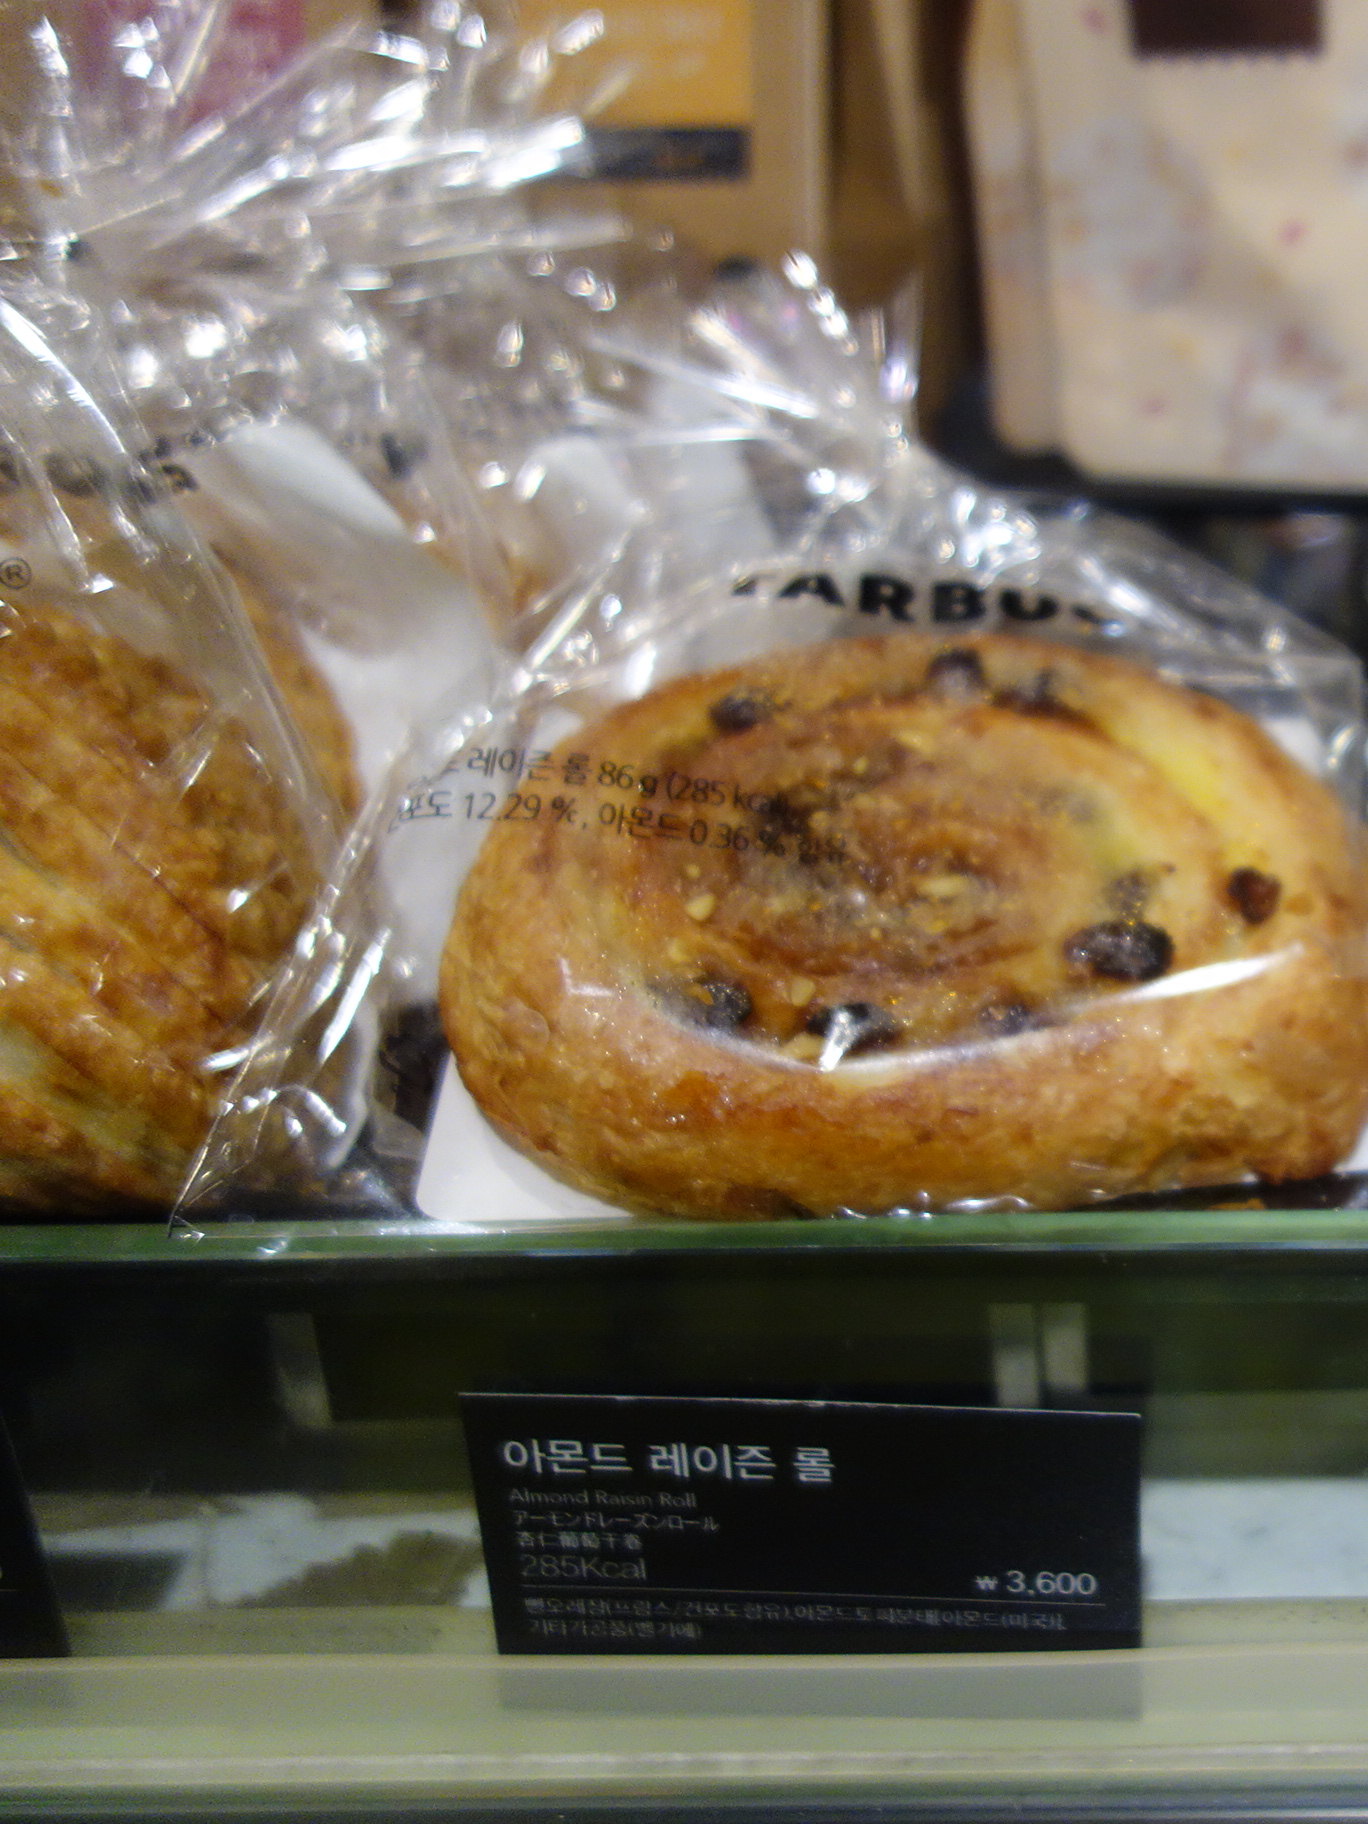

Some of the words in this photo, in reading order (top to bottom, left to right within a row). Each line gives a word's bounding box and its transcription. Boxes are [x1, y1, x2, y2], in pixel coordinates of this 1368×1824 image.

[467, 747, 555, 782] 레이즌
[563, 752, 592, 786] 롤
[597, 761, 634, 790] 86
[465, 792, 542, 821] 12.29
[598, 802, 688, 841] 아몬드
[503, 1439, 633, 1474] 아몬드
[649, 1443, 777, 1480] 레이즌
[793, 1447, 836, 1483] 롤
[508, 1488, 589, 1505] Almond
[595, 1490, 653, 1506] Raisin
[659, 1492, 698, 1508] Roll
[520, 1553, 648, 1581] 285Kcal
